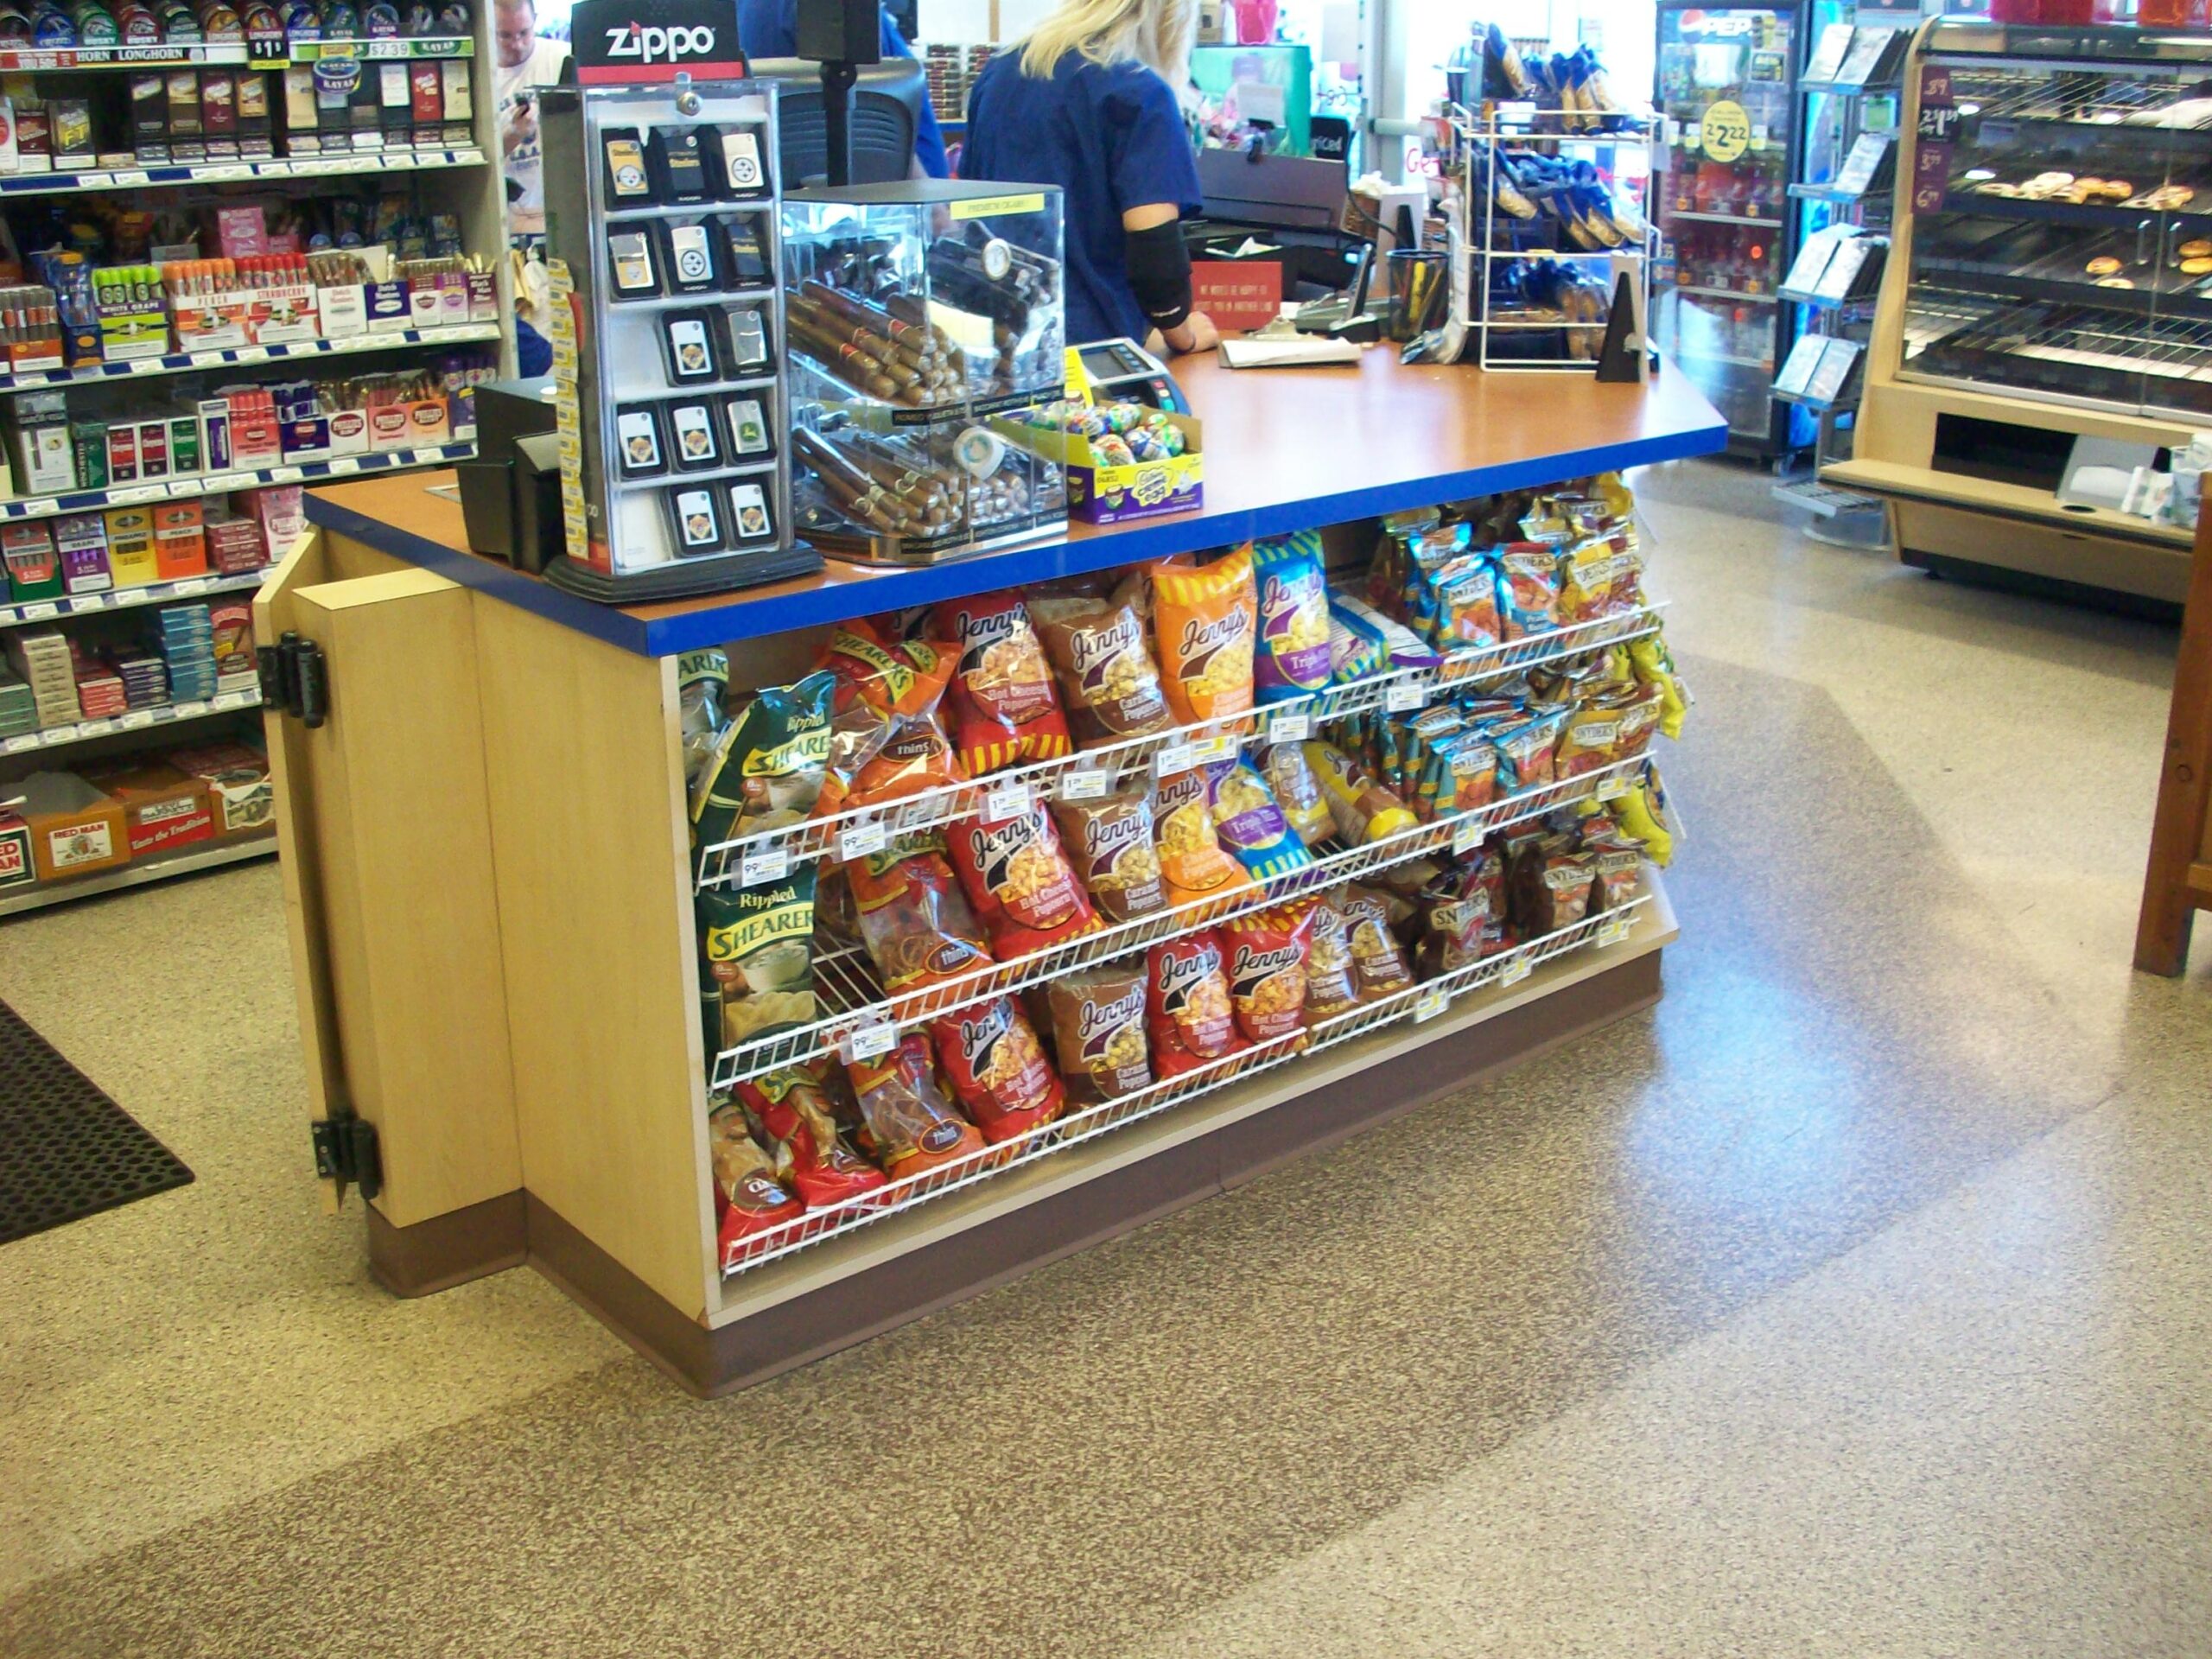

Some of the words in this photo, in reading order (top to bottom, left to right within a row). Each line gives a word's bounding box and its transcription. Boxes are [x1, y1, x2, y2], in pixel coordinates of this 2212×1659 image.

[118, 48, 183, 61] LONGHORN
[957, 602, 1030, 640] Jenny's
[1179, 604, 1249, 655] Jenny's
[897, 741, 931, 755] thins
[0, 842, 18, 853] ED
[740, 886, 797, 908] Rippled
[1233, 938, 1302, 976] Jenny's
[1080, 988, 1145, 1037] Jenny's
